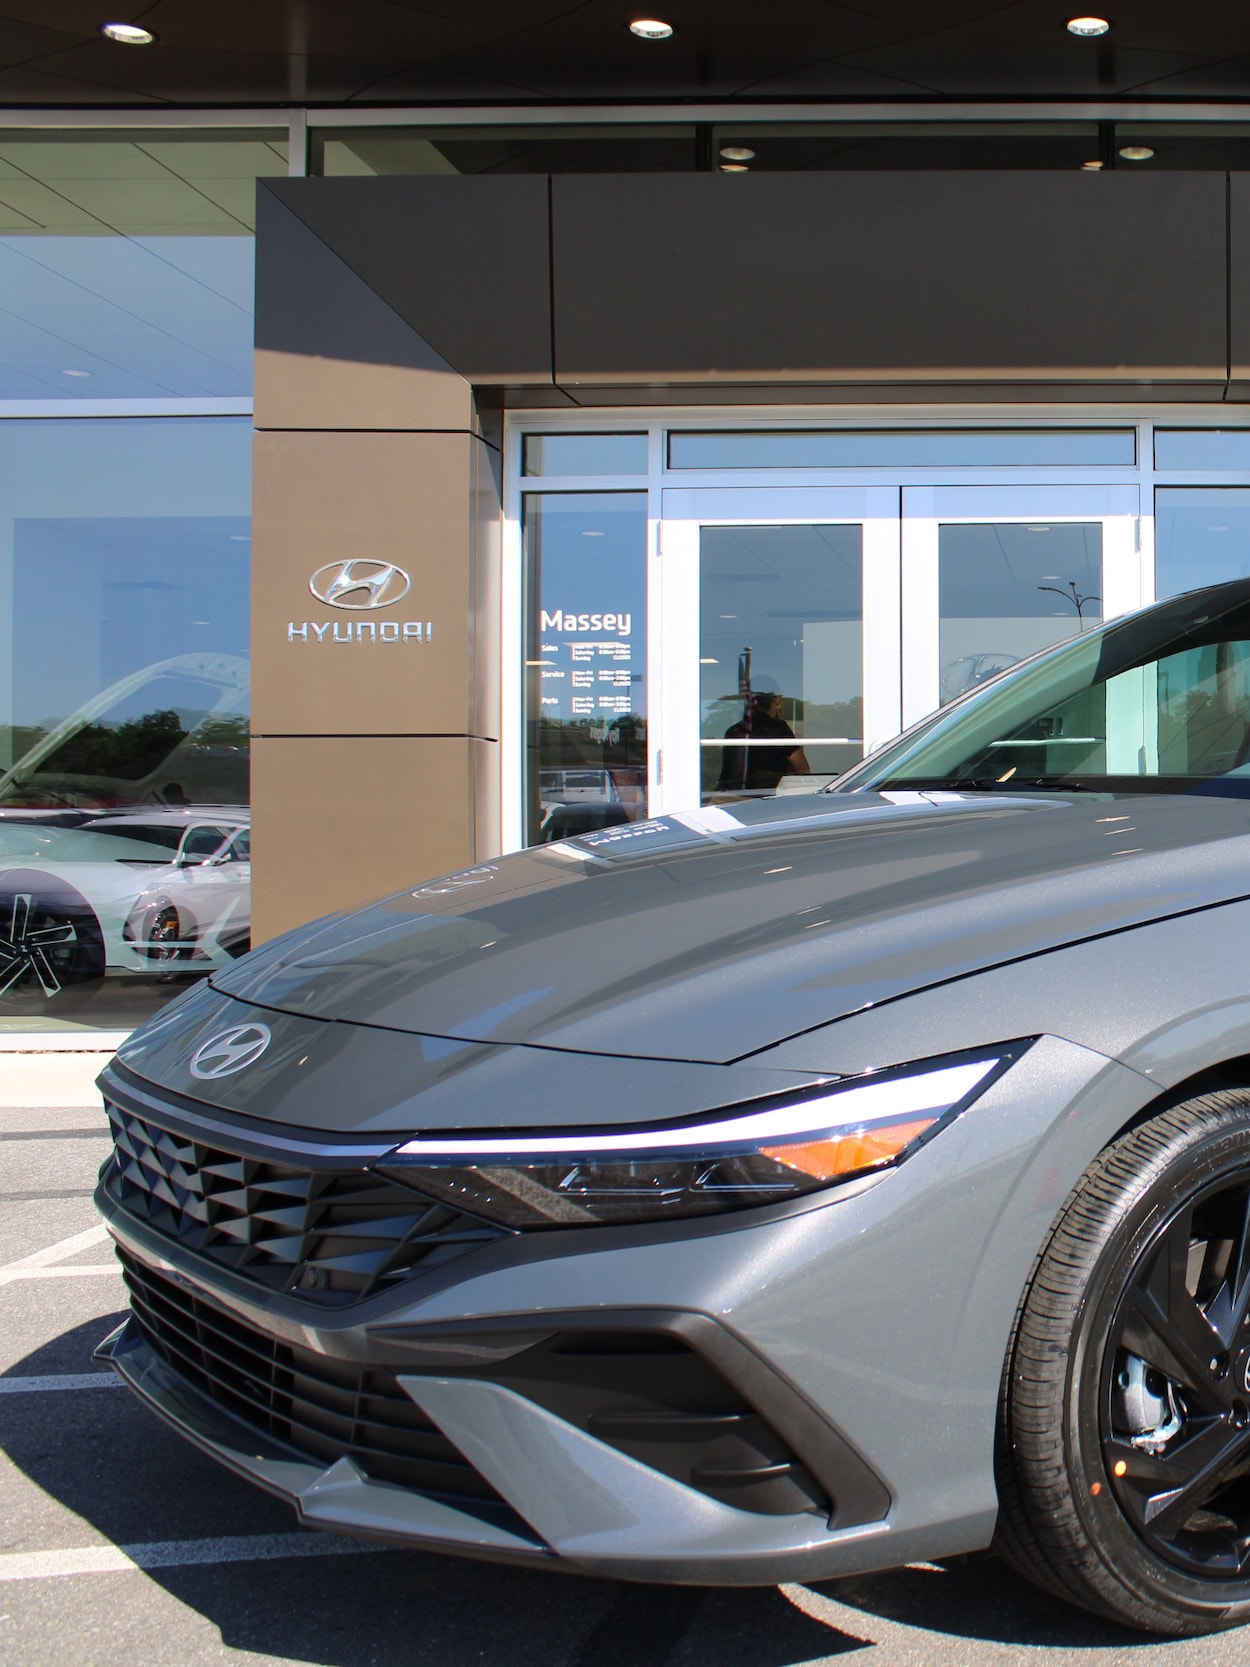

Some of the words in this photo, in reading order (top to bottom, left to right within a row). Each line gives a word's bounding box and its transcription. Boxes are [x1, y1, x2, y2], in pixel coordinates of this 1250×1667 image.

[540, 609, 631, 636] Massey
[287, 621, 433, 644] HYUNDAI
[541, 644, 559, 652] Sales
[541, 670, 565, 678] Service
[541, 696, 559, 705] Parts
